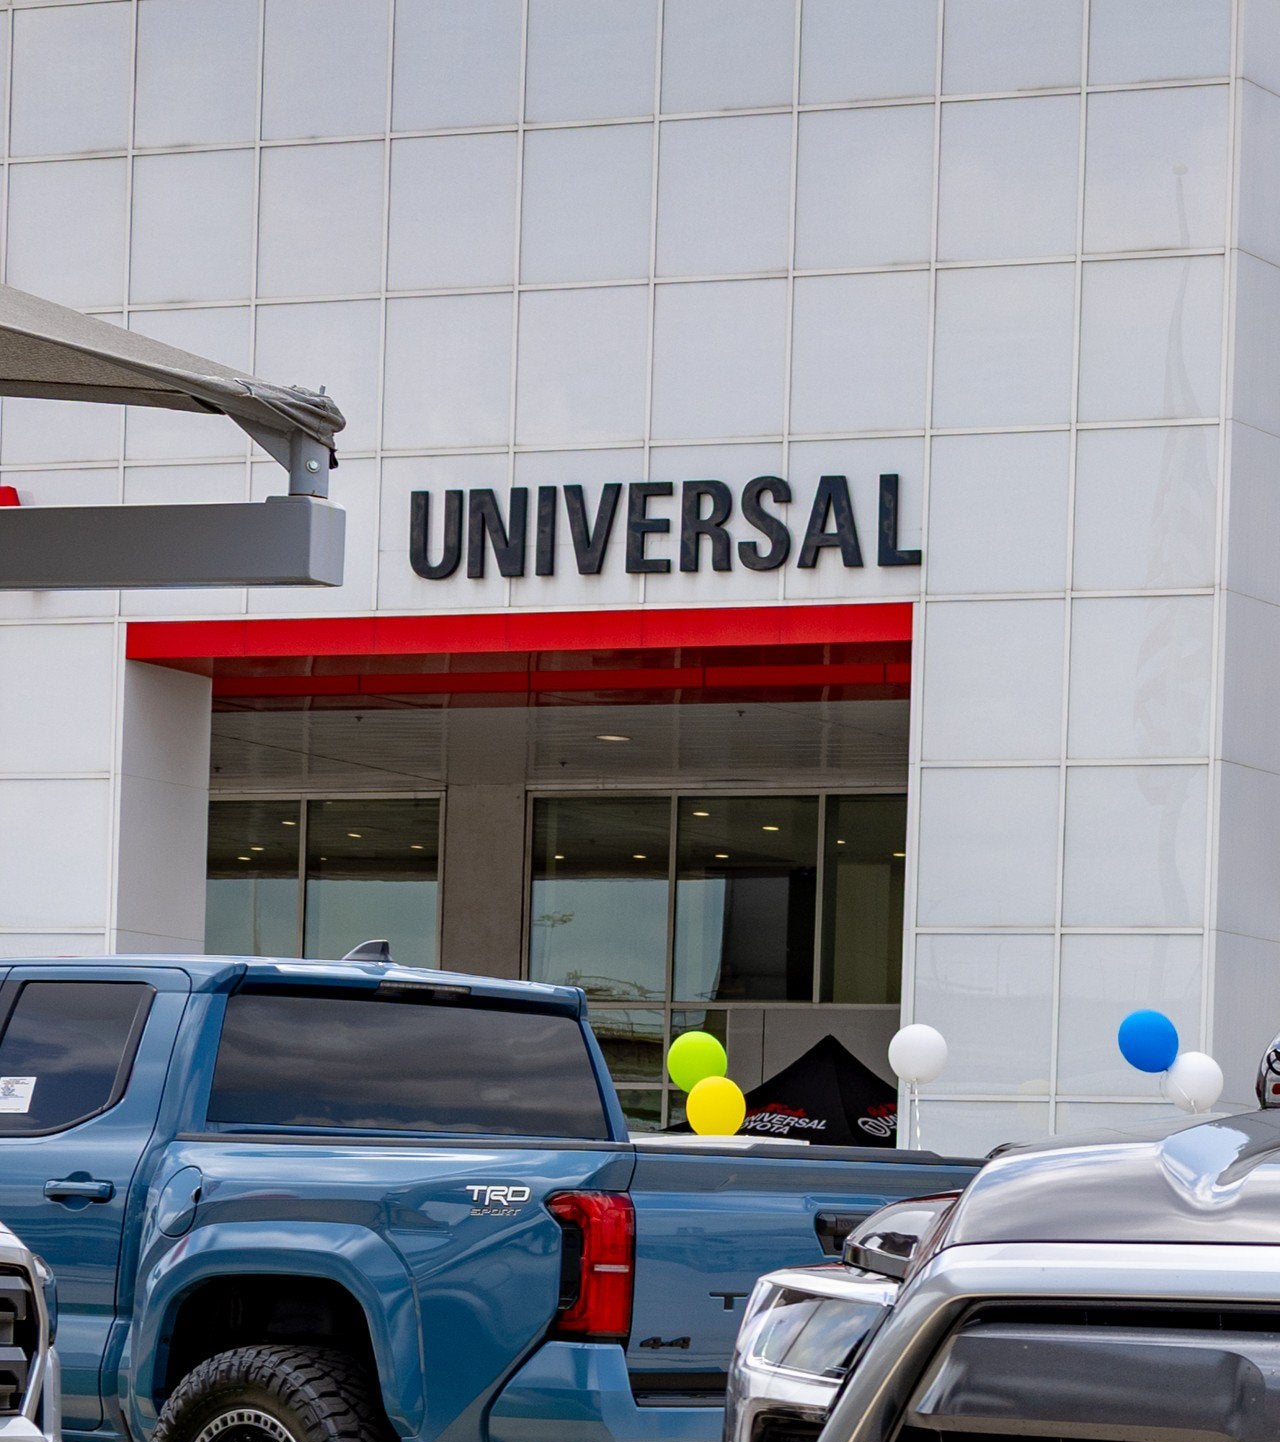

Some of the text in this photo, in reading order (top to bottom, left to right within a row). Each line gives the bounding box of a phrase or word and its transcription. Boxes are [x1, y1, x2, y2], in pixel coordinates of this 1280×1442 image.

[409, 473, 923, 580] UNIVERSAL
[743, 1112, 827, 1130] NIVERSAL
[465, 1184, 531, 1206] TRD
[469, 1207, 522, 1216] SPORT
